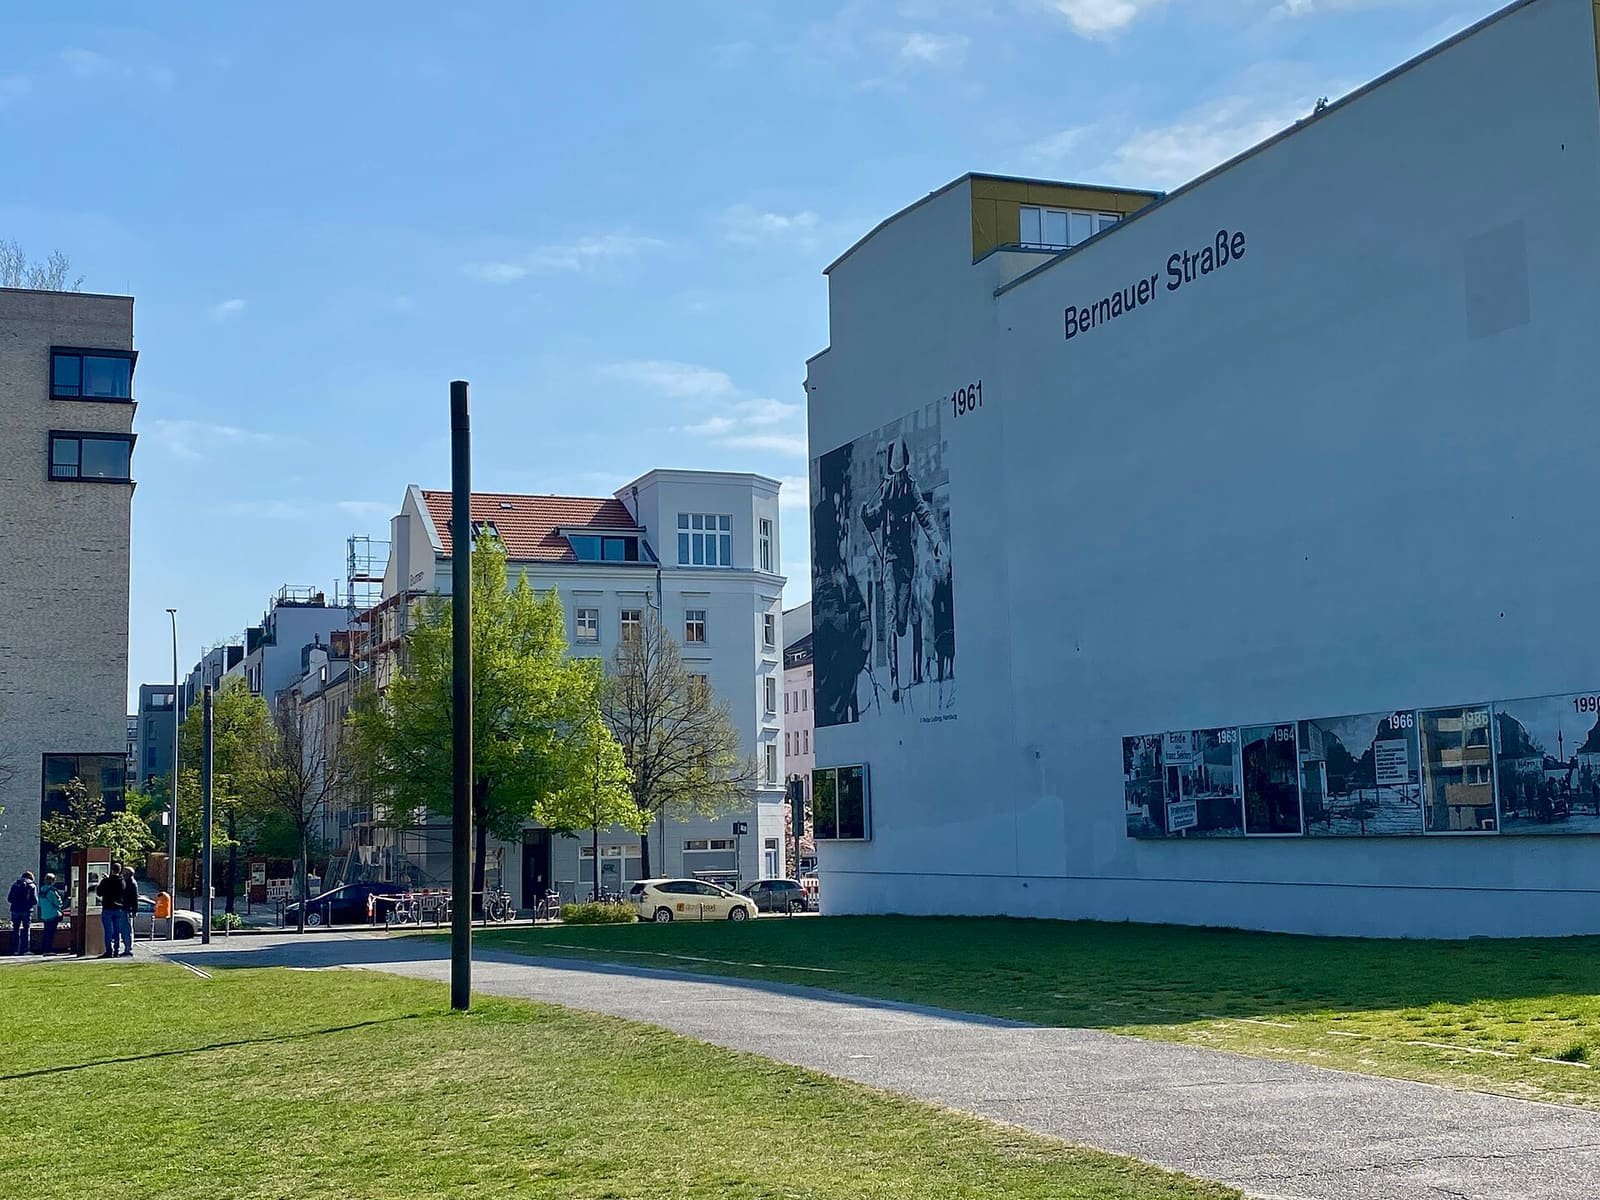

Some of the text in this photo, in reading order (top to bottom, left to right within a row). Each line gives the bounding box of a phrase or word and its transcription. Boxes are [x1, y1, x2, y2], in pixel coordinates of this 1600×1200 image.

[1064, 229, 1246, 340] Bernauer Straße
[951, 379, 983, 419] 1961
[1388, 713, 1414, 729] 1966
[1461, 711, 1488, 726] 1986
[1169, 733, 1187, 744] Ende
[1217, 730, 1238, 744] 1963
[1273, 728, 1295, 742] 1964
